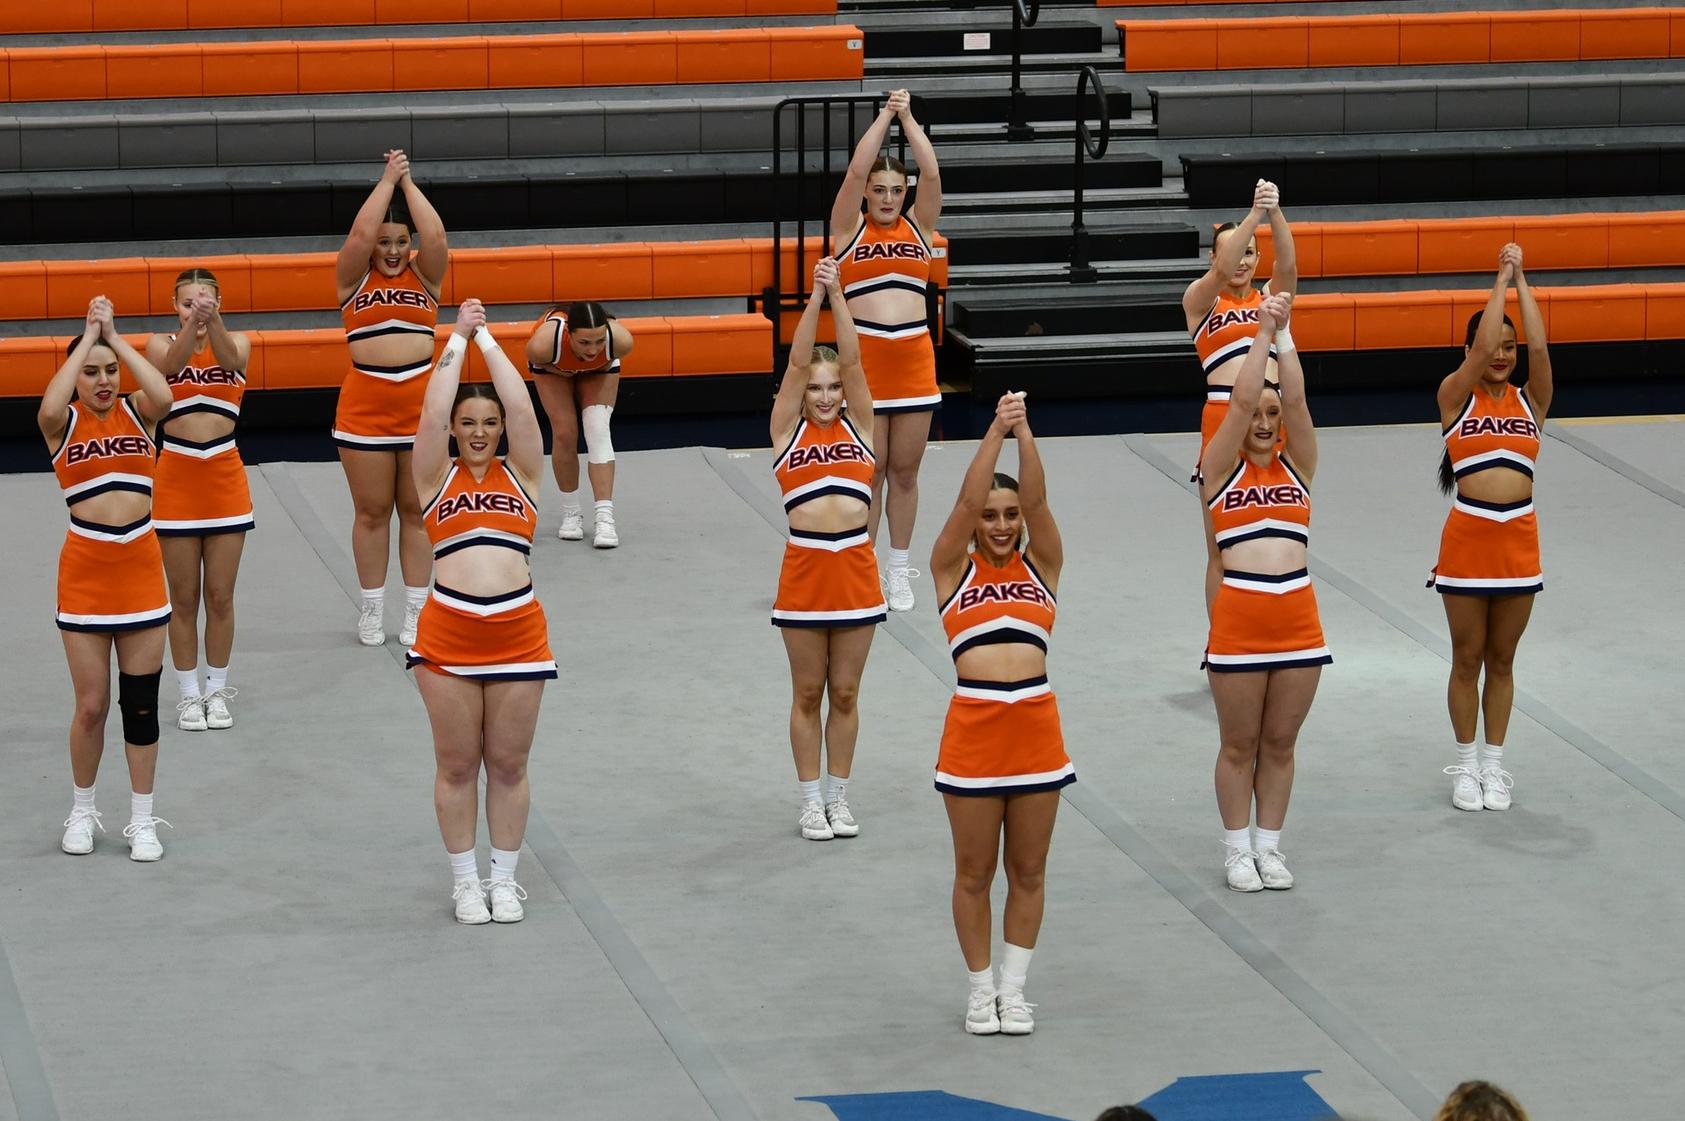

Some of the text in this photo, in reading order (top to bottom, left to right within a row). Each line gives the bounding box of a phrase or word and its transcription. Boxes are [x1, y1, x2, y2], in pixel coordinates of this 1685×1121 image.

[853, 243, 928, 264] BAKER
[354, 289, 432, 314] BAKER
[1207, 309, 1260, 337] BAK
[1460, 416, 1539, 442] BAKER
[67, 437, 151, 466] BAKER
[788, 443, 870, 472] BAKER
[438, 492, 528, 526] BAKER
[1223, 485, 1308, 512] BAKER
[958, 582, 1052, 614] BAKER
